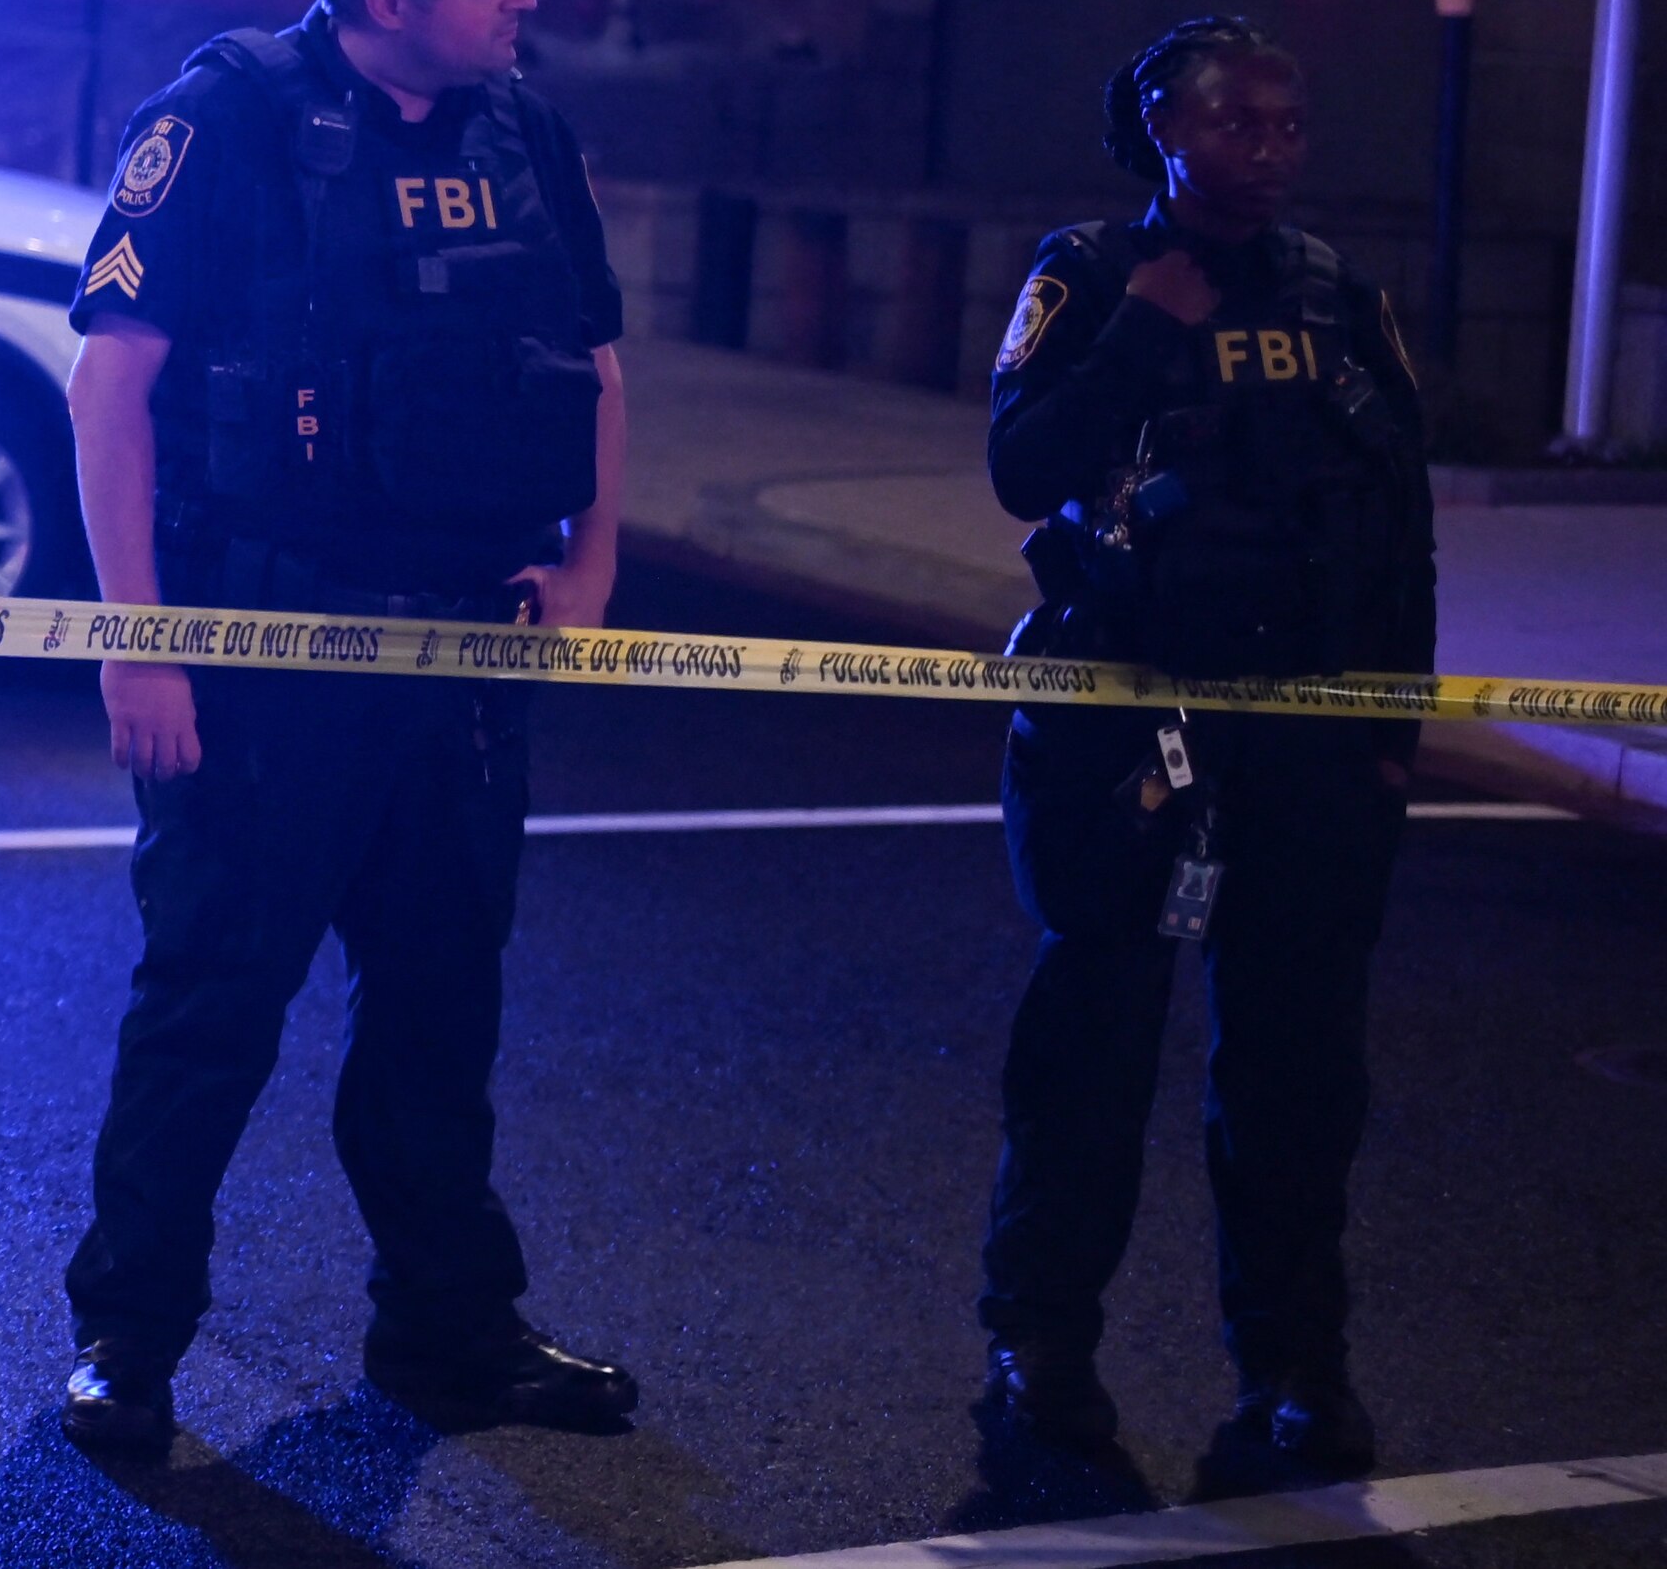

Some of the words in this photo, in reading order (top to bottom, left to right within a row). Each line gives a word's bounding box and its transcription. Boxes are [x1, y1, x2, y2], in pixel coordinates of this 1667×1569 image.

[152, 121, 175, 135] FBI
[116, 188, 153, 206] POLICE
[395, 177, 498, 230] FBI
[1216, 329, 1319, 382] FBI
[296, 388, 320, 462] FBI
[87, 615, 168, 651] POLICE
[169, 619, 222, 655] LINE
[223, 621, 257, 657] DO
[259, 623, 308, 659] NOT
[308, 625, 383, 663] CROSS
[458, 632, 538, 669] POLICE
[538, 636, 590, 671] LINE
[590, 638, 623, 673] DO
[626, 640, 671, 675] NOT
[671, 643, 747, 679] CROSS
[819, 652, 895, 685] POLICE
[897, 656, 946, 688] LINE
[947, 659, 980, 689] DO
[981, 661, 1025, 691] NOT
[1027, 663, 1100, 694] CROSS
